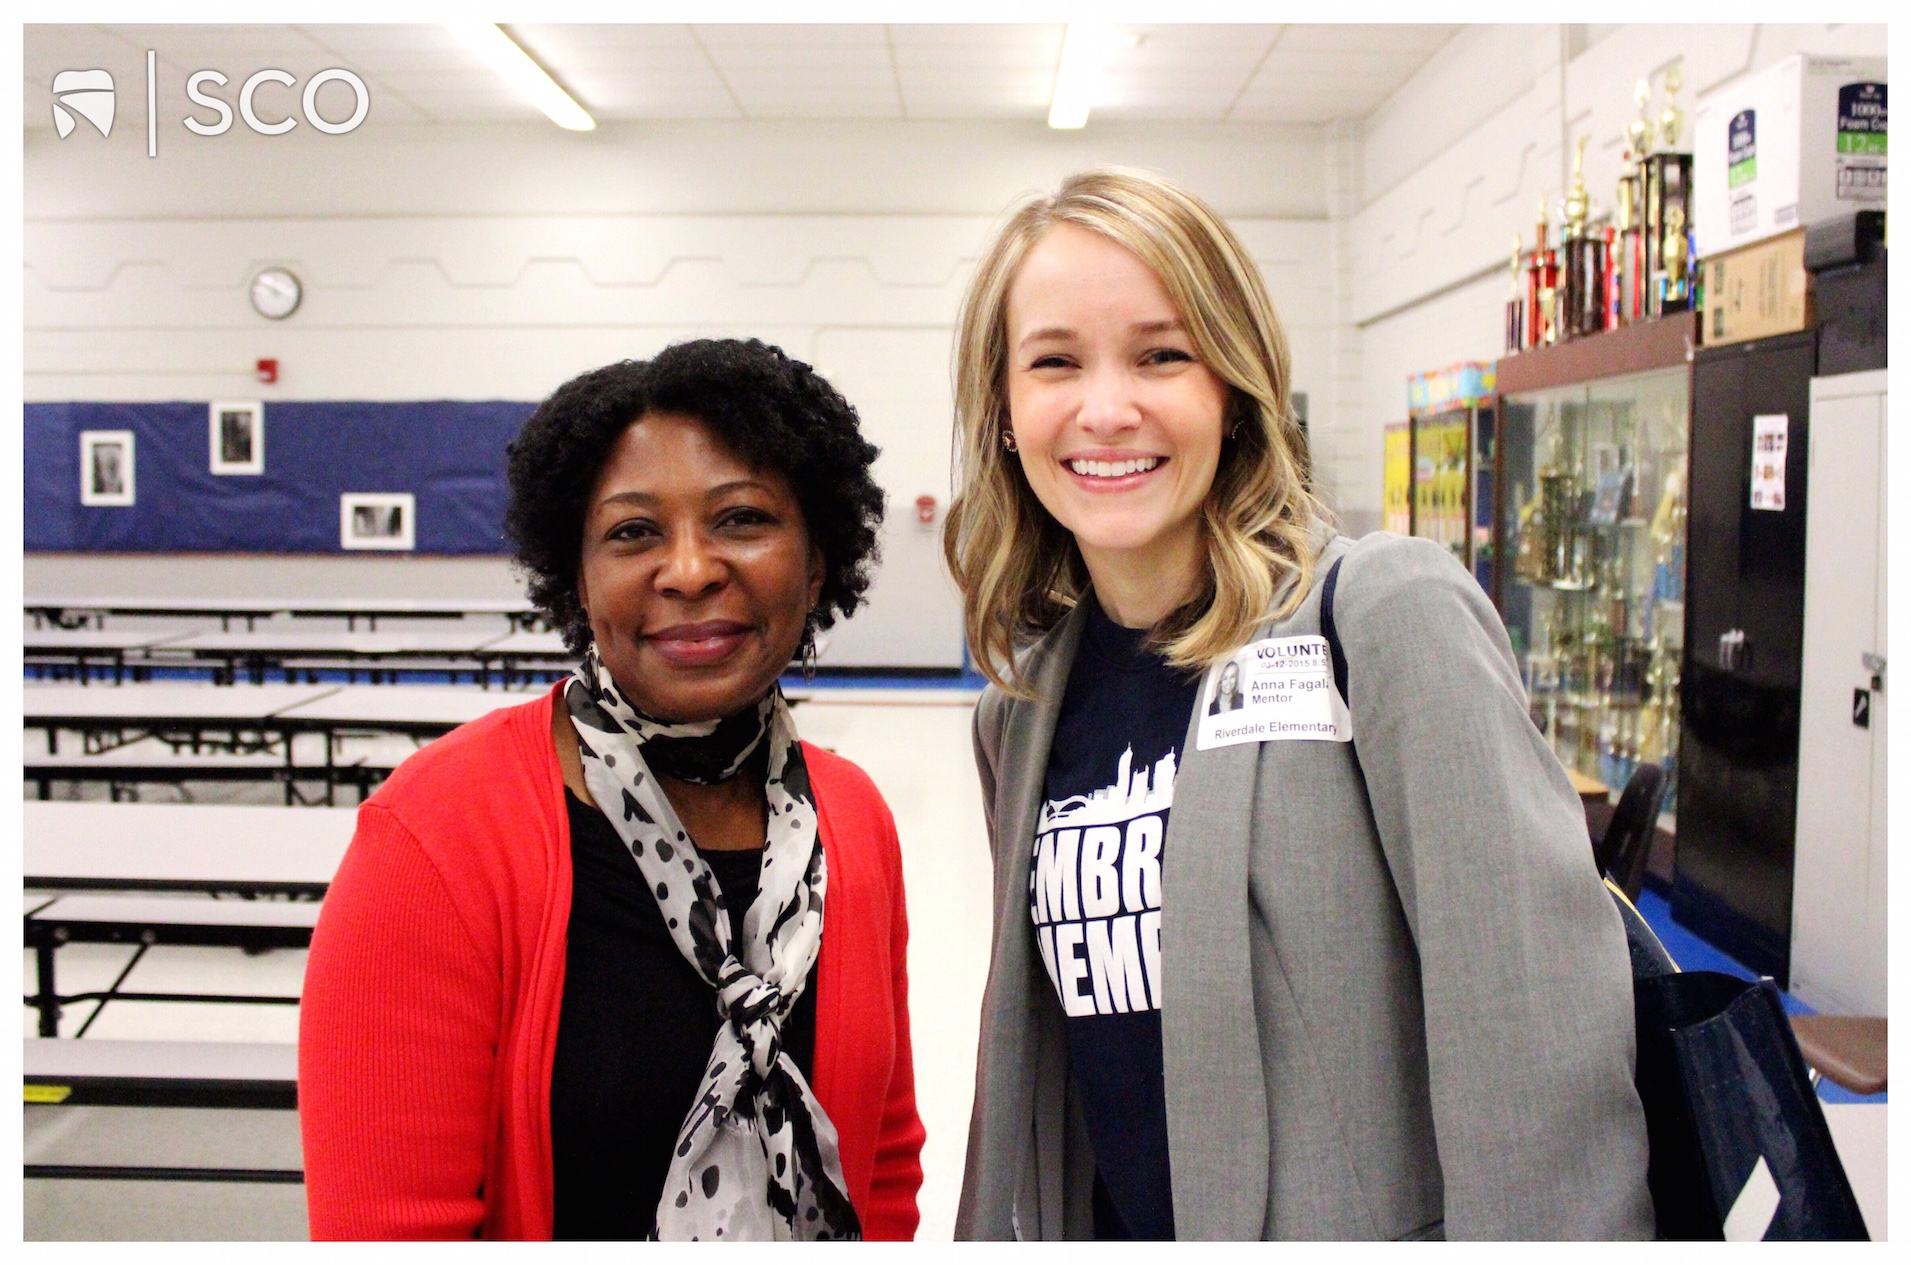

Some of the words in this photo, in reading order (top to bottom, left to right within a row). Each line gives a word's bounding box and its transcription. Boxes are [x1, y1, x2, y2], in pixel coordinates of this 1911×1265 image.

[1251, 681, 1285, 692] Anna
[1252, 694, 1293, 705] Mentor
[1214, 723, 1265, 740] Riverdale
[1269, 721, 1337, 735] Elementary
